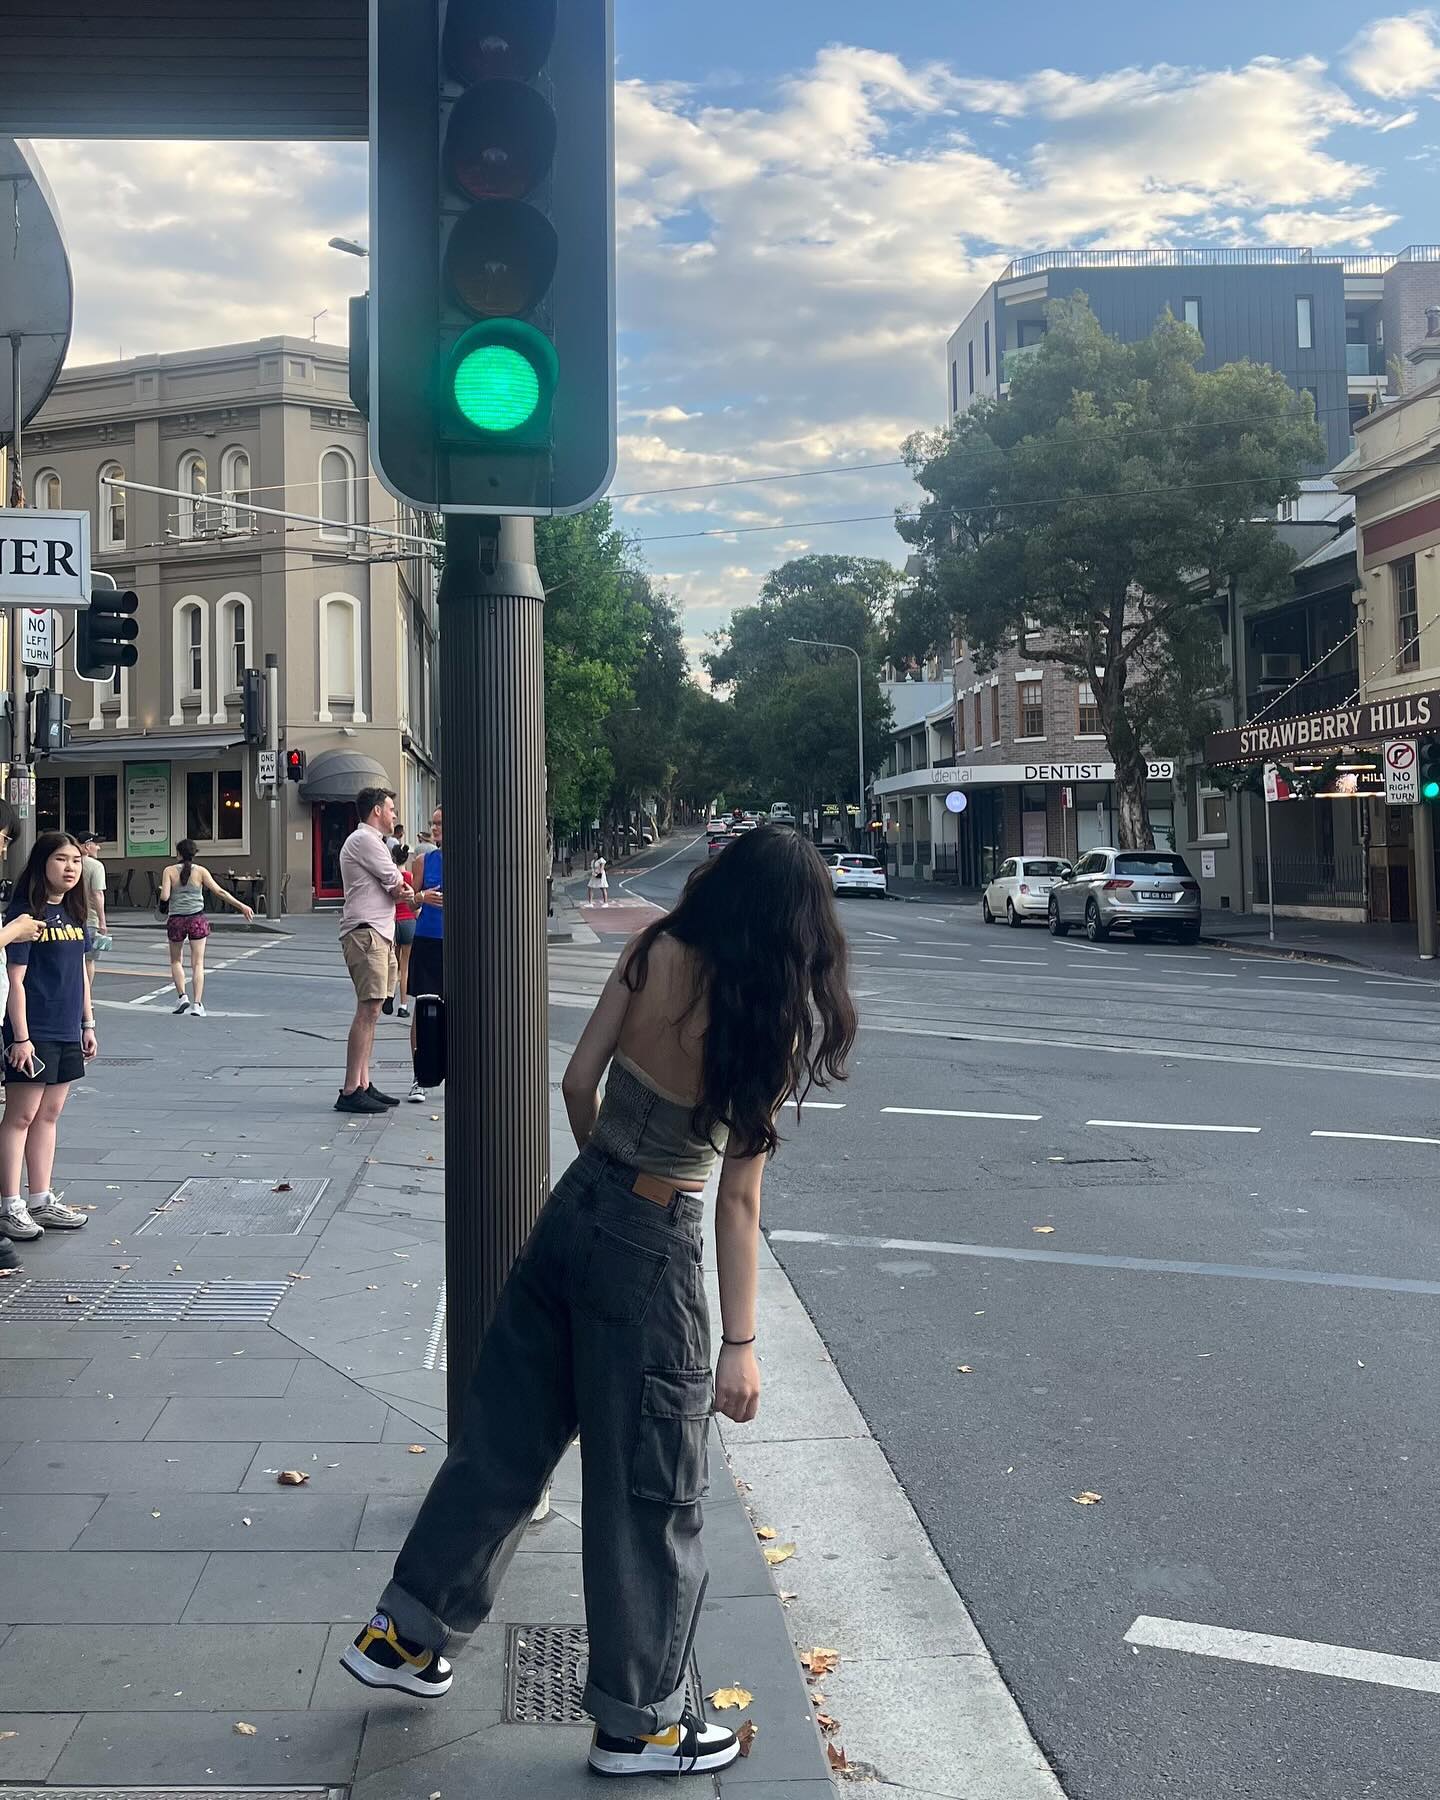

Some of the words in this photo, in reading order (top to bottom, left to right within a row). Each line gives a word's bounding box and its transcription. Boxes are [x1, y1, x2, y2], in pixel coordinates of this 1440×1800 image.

[28, 618, 46, 633] NO
[26, 635, 48, 647] LEFT
[25, 649, 49, 661] TURN
[1240, 710, 1362, 754] STRAWBERRY
[1370, 697, 1431, 733] HILLS
[260, 753, 275, 763] ONE
[260, 764, 275, 773] WAY
[1024, 764, 1103, 780] DENTIST
[1392, 771, 1411, 782] NO
[1389, 783, 1415, 791] RIGHT
[1391, 792, 1415, 801] TURN
